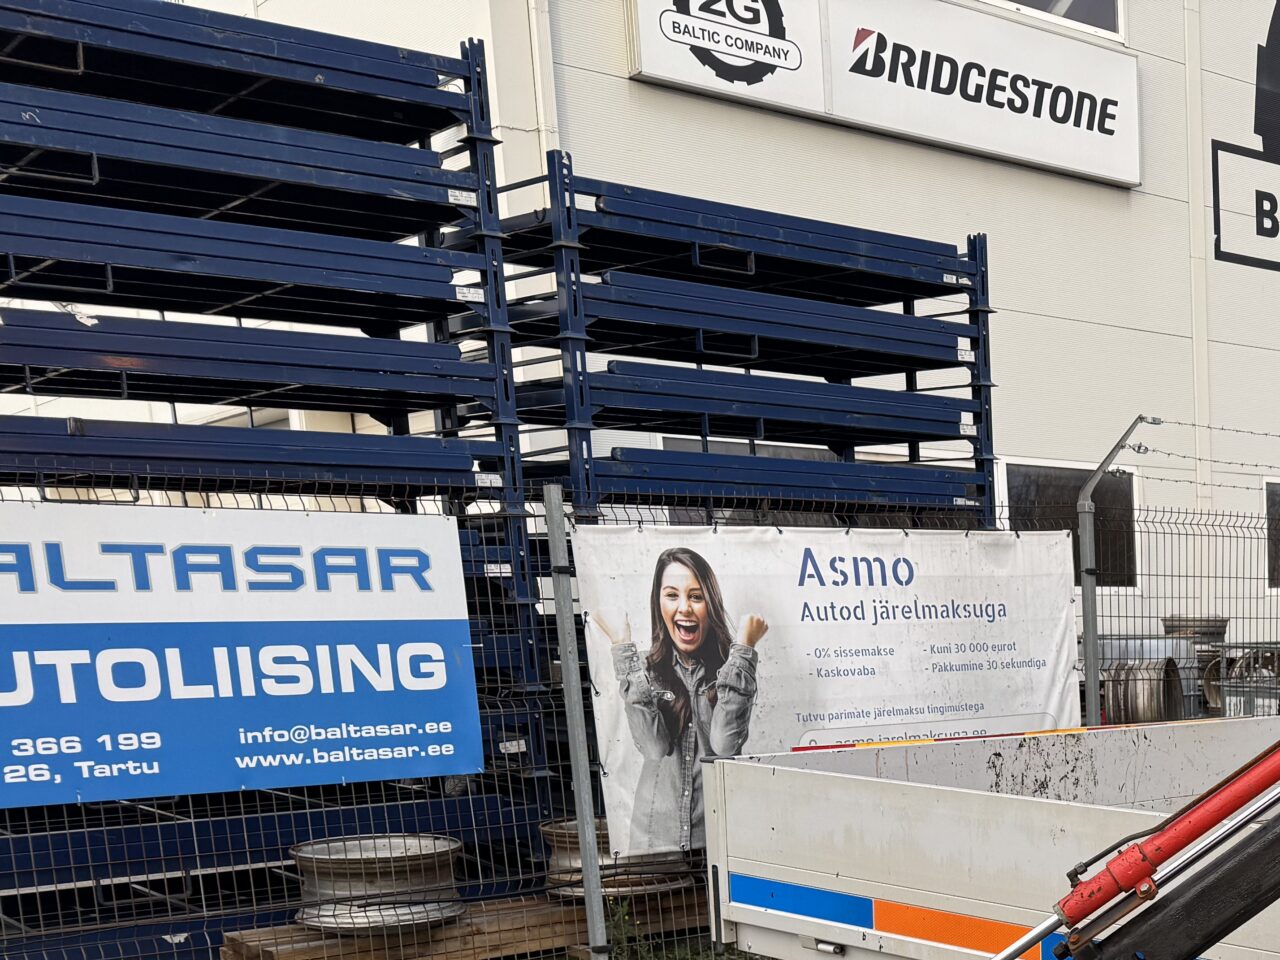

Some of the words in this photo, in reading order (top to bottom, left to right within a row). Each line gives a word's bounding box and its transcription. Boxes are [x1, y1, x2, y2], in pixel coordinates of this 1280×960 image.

[672, 20, 721, 44] BALTIC
[724, 34, 790, 61] COMPANY
[849, 27, 1119, 137] BRIDGESTONE
[797, 547, 915, 587] Asmo
[800, 600, 866, 622] Autod
[871, 599, 1007, 626] järelmaksuga
[814, 647, 831, 660] 0%
[833, 645, 895, 659] sissemakse
[929, 643, 953, 655] Kuni
[953, 643, 967, 654] 30
[968, 642, 989, 653] 000
[990, 641, 1017, 653] eurot
[816, 665, 876, 678] Kaskovaba
[931, 660, 984, 674] Pakkumine
[986, 660, 998, 671] 30
[1000, 657, 1047, 671] sekundiga
[795, 711, 826, 724] Tutvu
[827, 709, 871, 723] parimate
[873, 706, 925, 720] järelmaksu
[927, 702, 985, 716] tingimustega
[11, 735, 83, 757] 366
[96, 731, 162, 752] 199
[238, 718, 453, 746] info@baltasar.ee
[234, 740, 455, 769] www.baltasar.ee
[3, 763, 62, 784] 26,
[73, 760, 160, 778] Tartu
